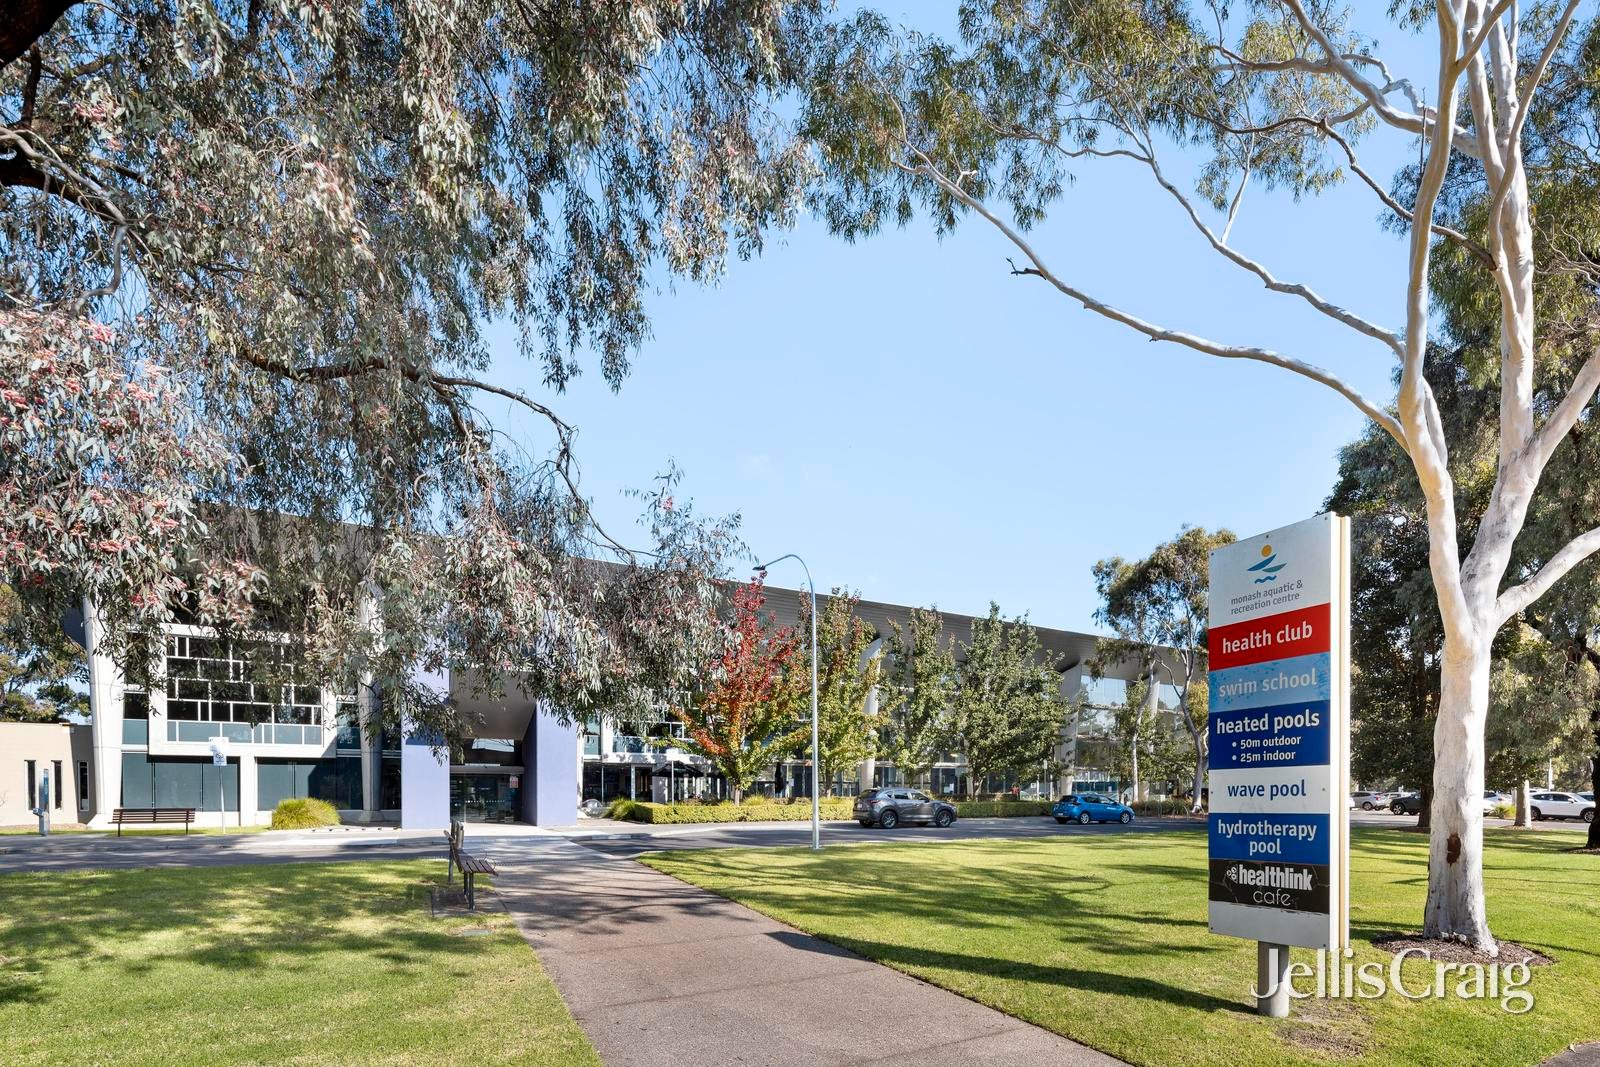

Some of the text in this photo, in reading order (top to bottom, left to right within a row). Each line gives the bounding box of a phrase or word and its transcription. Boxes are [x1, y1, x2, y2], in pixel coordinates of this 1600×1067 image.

[1231, 579, 1303, 605] monash aquatic &
[1231, 592, 1300, 615] recreation centre
[1222, 621, 1313, 654] health club
[1219, 667, 1318, 697] swim school
[1216, 709, 1320, 734] heated pools
[1240, 735, 1301, 749] 50m outdoor
[1240, 750, 1296, 763] 25m indoor
[1227, 779, 1306, 801] wave pool
[1218, 819, 1317, 841] hydrotherapy
[1249, 838, 1281, 856] pool
[1239, 864, 1313, 891] healthlink
[1253, 888, 1291, 906] cafe
